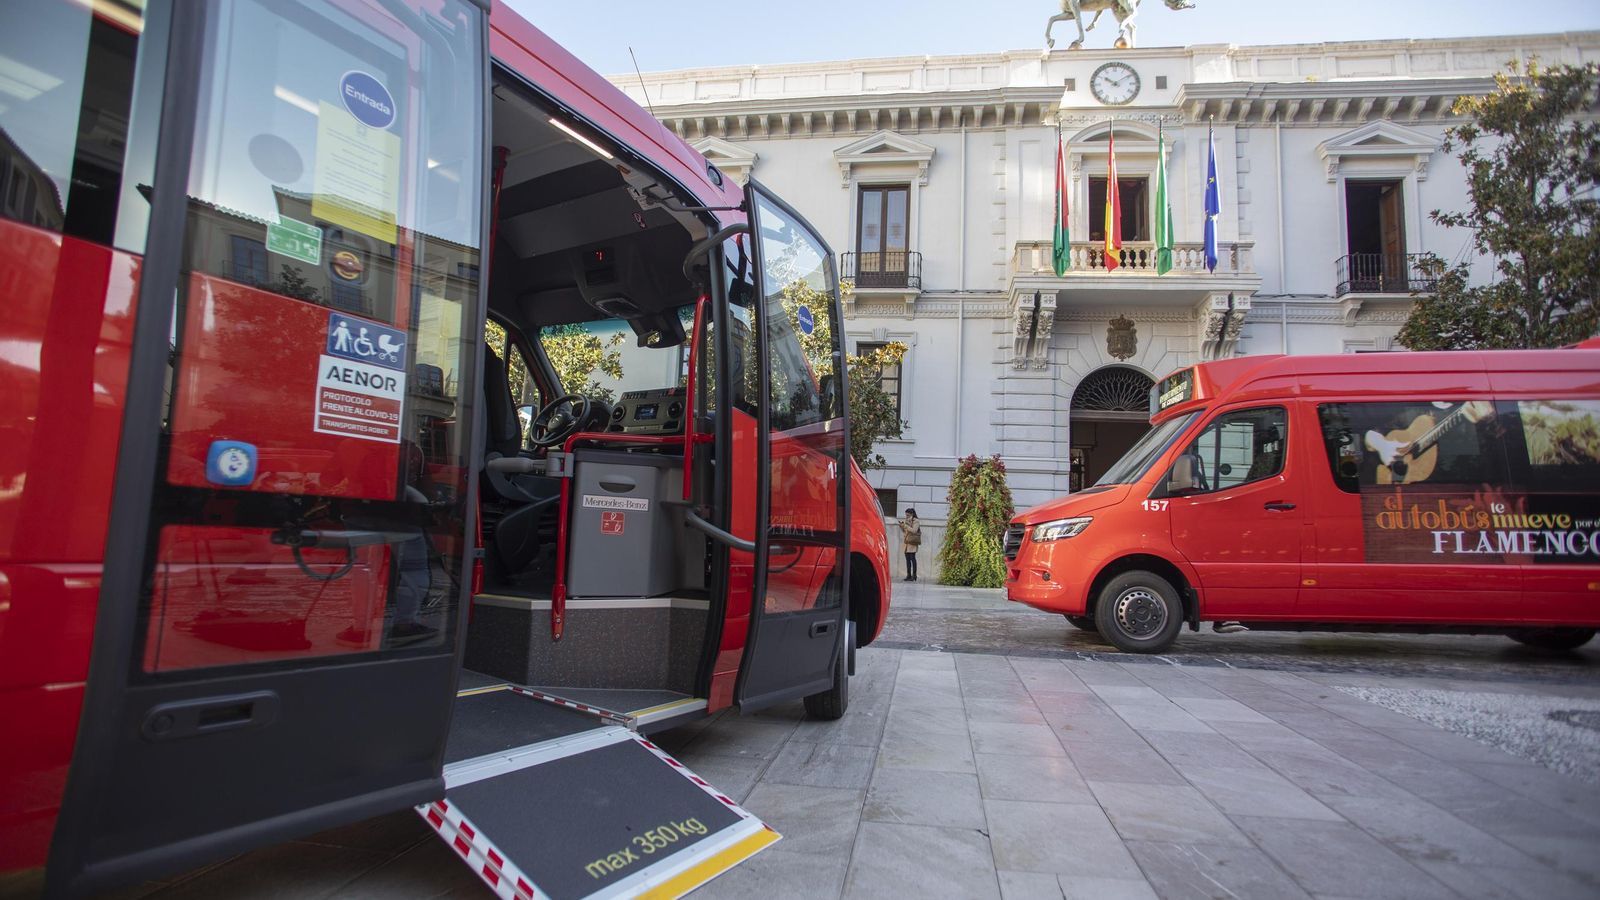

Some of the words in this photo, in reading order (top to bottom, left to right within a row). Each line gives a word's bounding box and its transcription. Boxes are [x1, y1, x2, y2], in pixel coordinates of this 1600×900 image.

[345, 83, 391, 116] Entrada
[326, 365, 397, 392] AENOR
[323, 391, 372, 406] PROTOCOLO
[322, 401, 354, 414] FRENTE
[354, 407, 364, 415] AL
[364, 409, 398, 421] COVID-19
[322, 419, 368, 432] TRANSPORTES
[585, 497, 647, 509] Mercedes-Benz
[1141, 499, 1169, 512] 157
[1384, 486, 1403, 511] el
[1376, 498, 1490, 530] autobús
[1490, 502, 1505, 514] te
[1492, 513, 1572, 529] mueve
[1575, 520, 1593, 530] por
[584, 847, 640, 879] max
[632, 825, 679, 854] 350
[670, 817, 708, 835] kg
